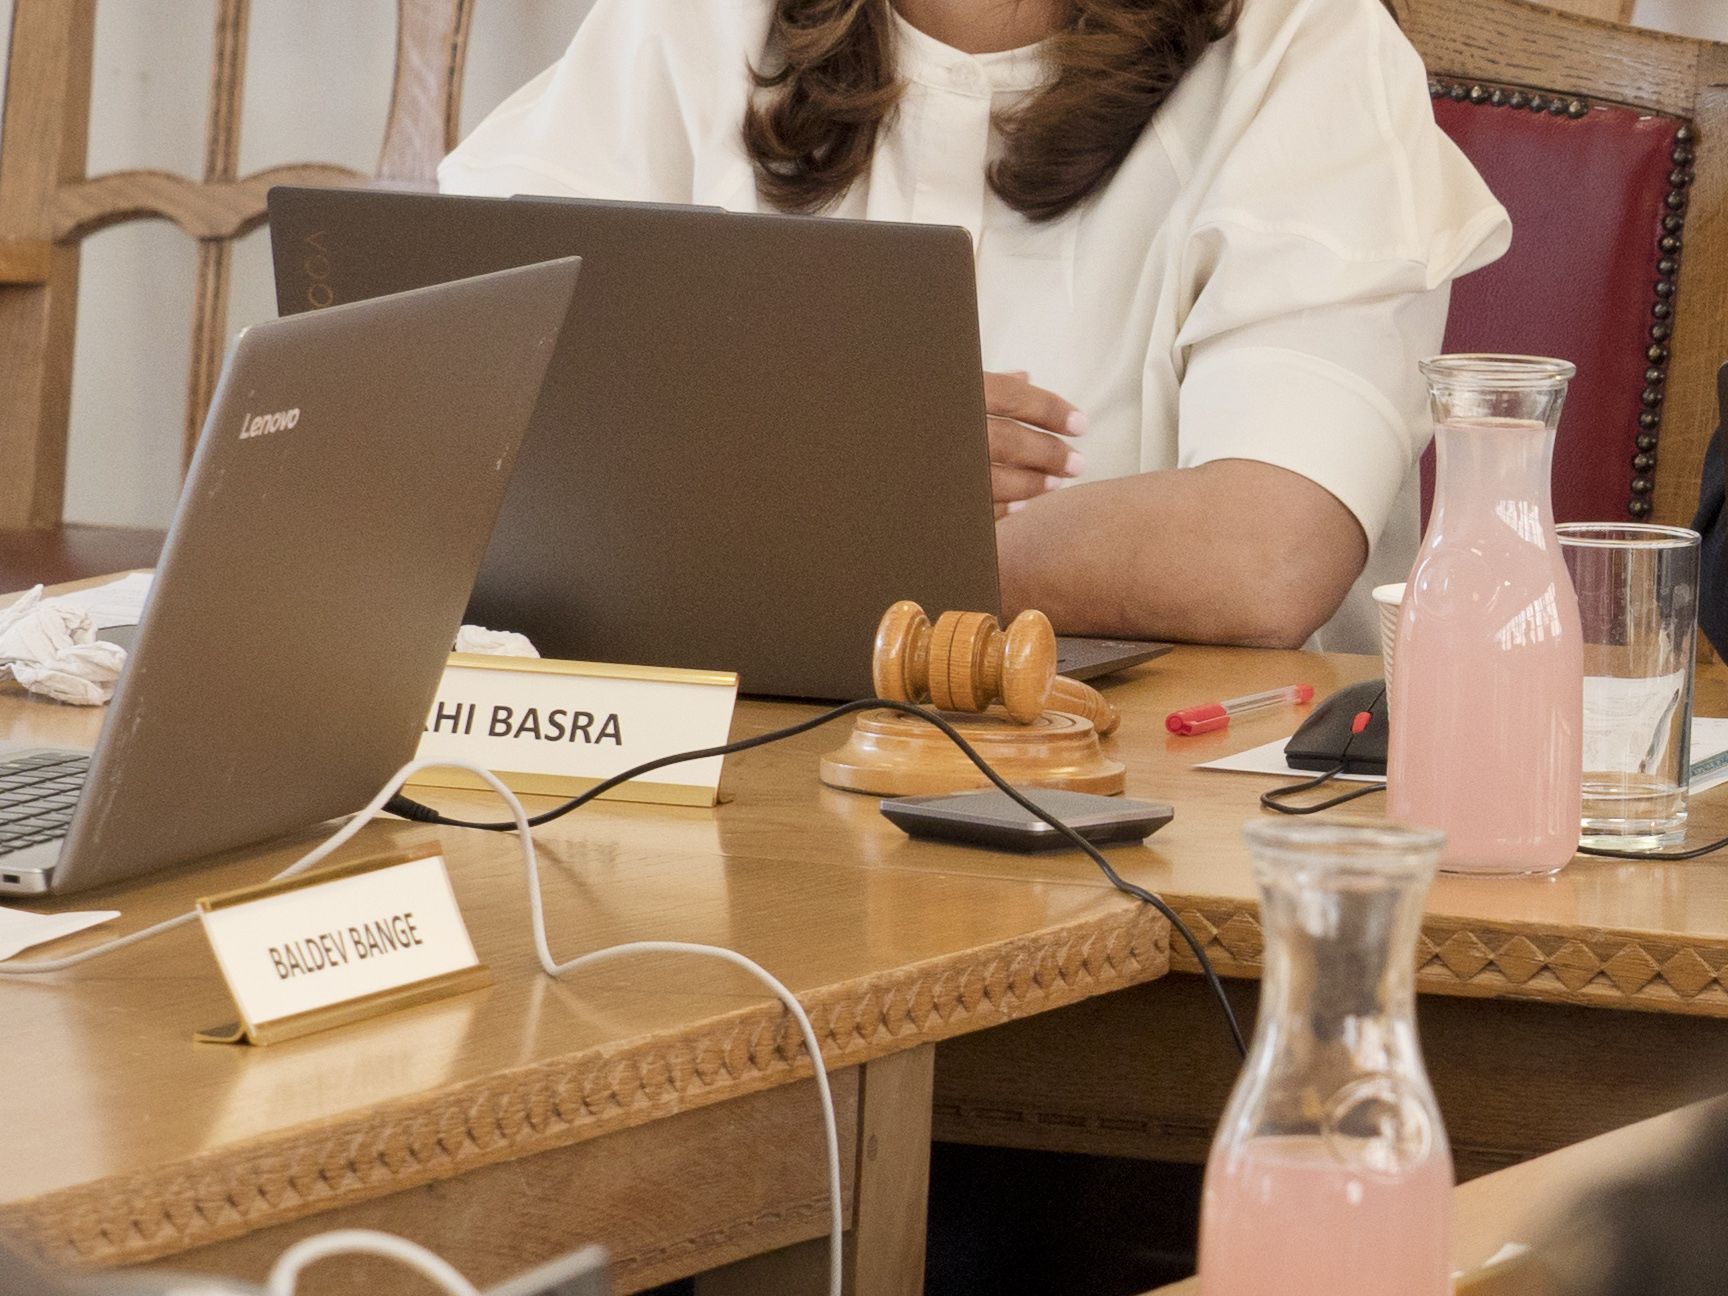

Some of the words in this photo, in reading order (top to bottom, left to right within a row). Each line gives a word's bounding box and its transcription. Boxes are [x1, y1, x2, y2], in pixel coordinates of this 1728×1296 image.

[239, 407, 301, 440] Lenovo
[422, 701, 477, 735] HI
[487, 705, 623, 746] BASRA
[268, 930, 350, 980] BALDEV
[348, 912, 424, 960] BANGE
